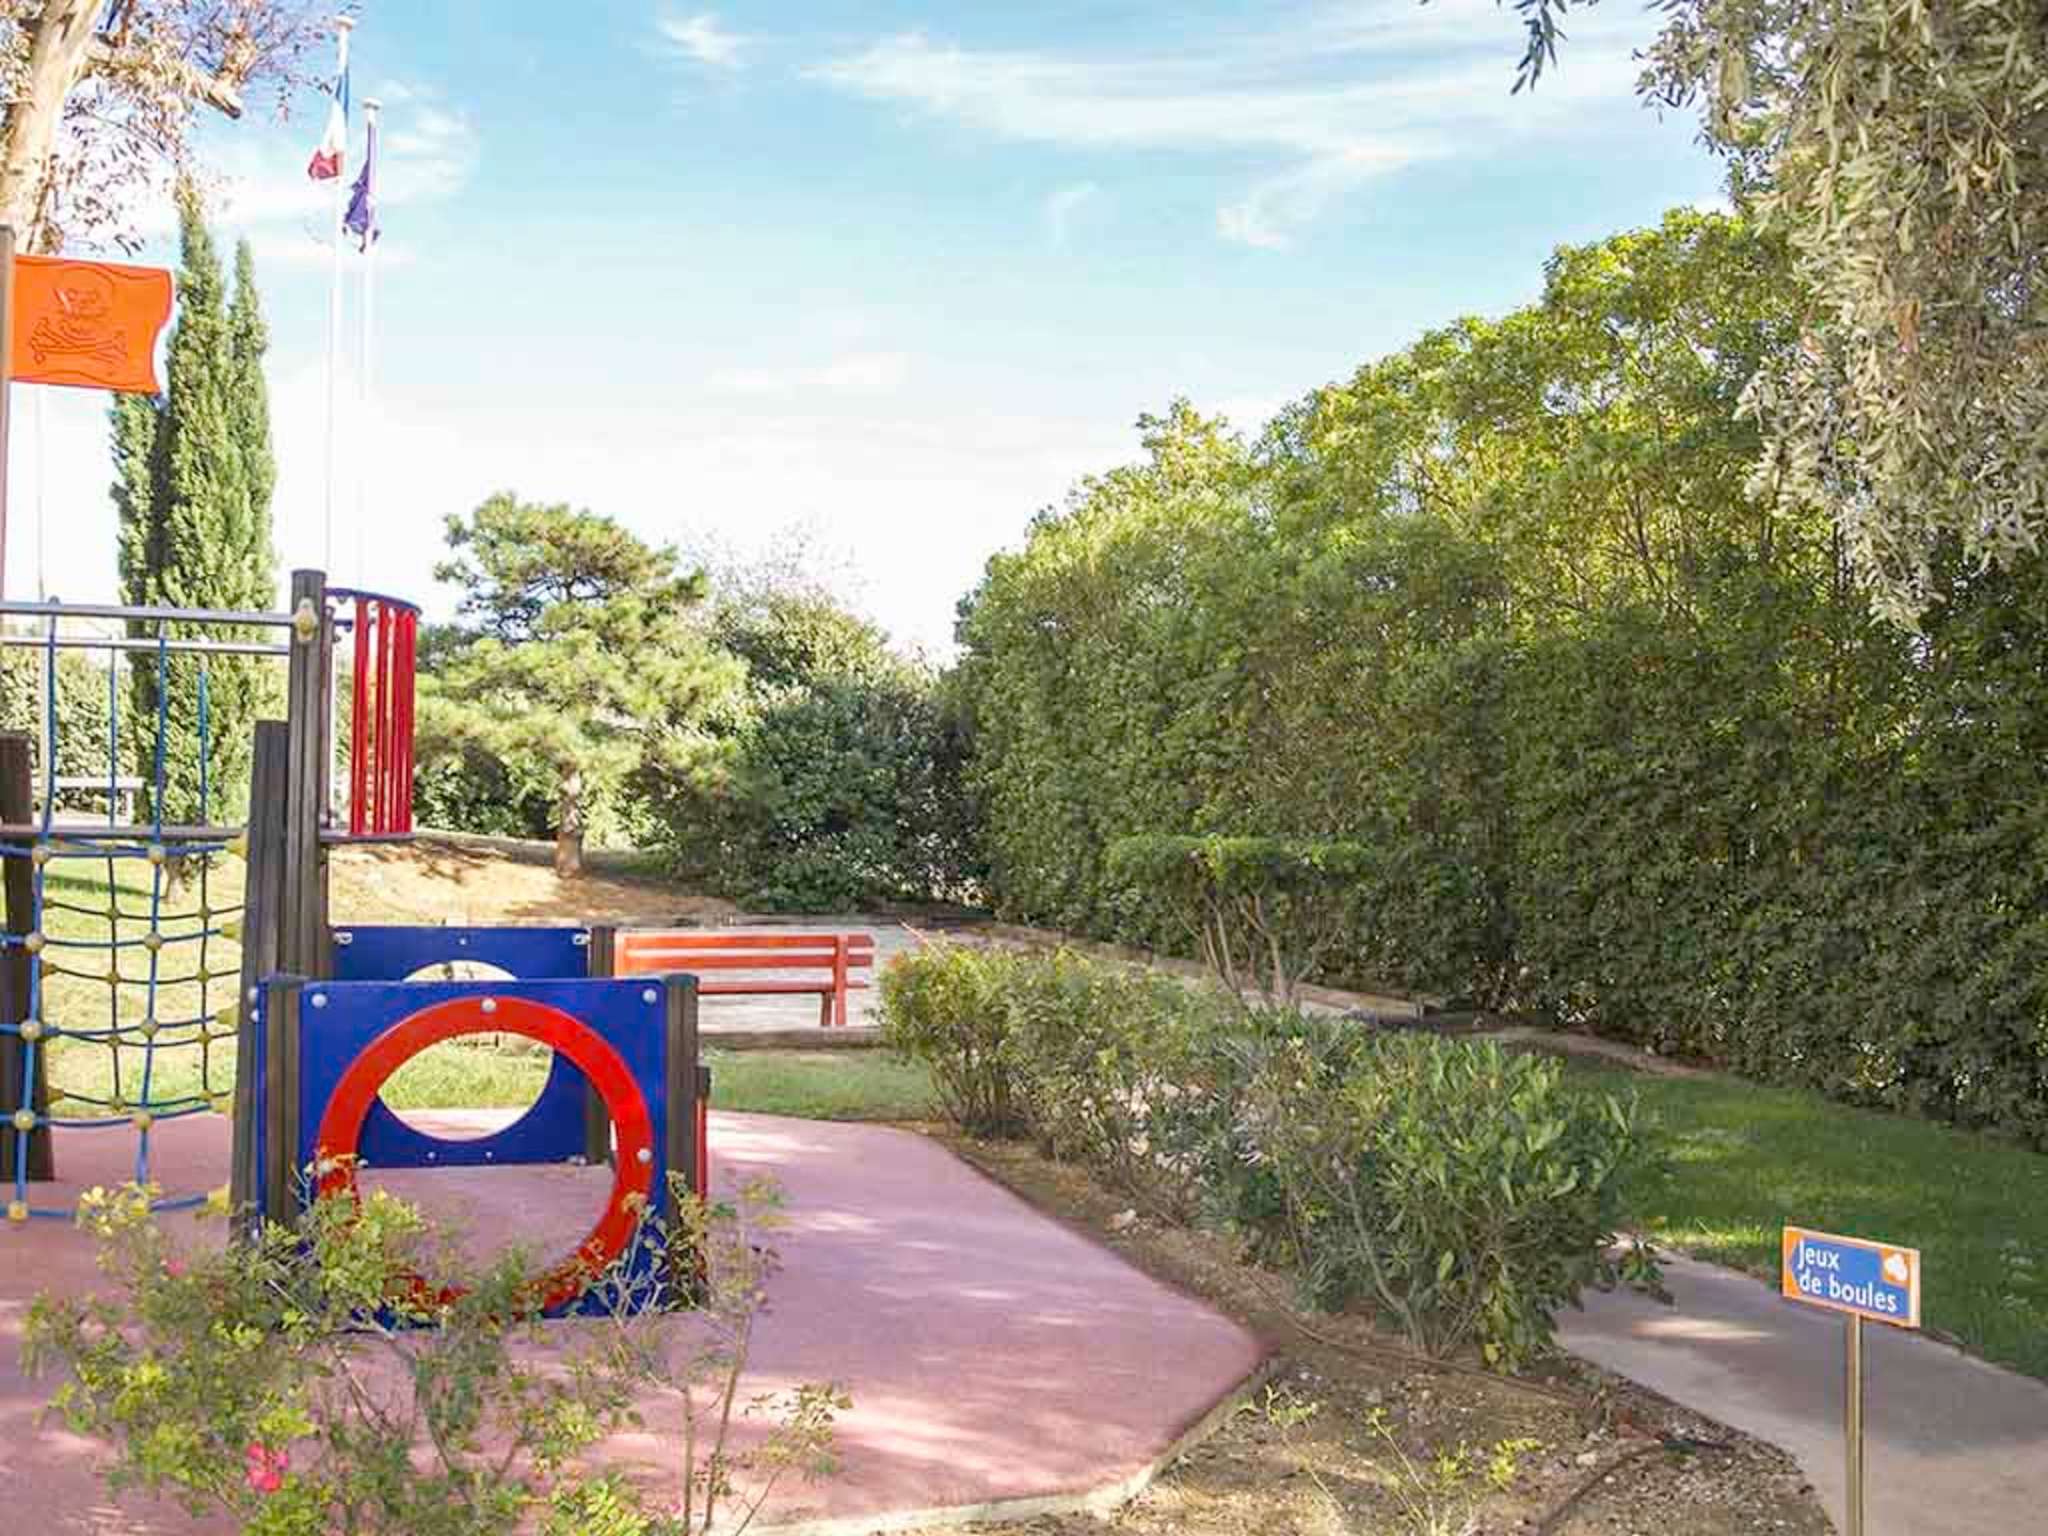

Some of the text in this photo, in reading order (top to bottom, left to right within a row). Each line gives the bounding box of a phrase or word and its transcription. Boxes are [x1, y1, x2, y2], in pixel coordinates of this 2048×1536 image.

[1798, 1239, 1840, 1270] Jeux
[1800, 1269, 1897, 1312] de boules
